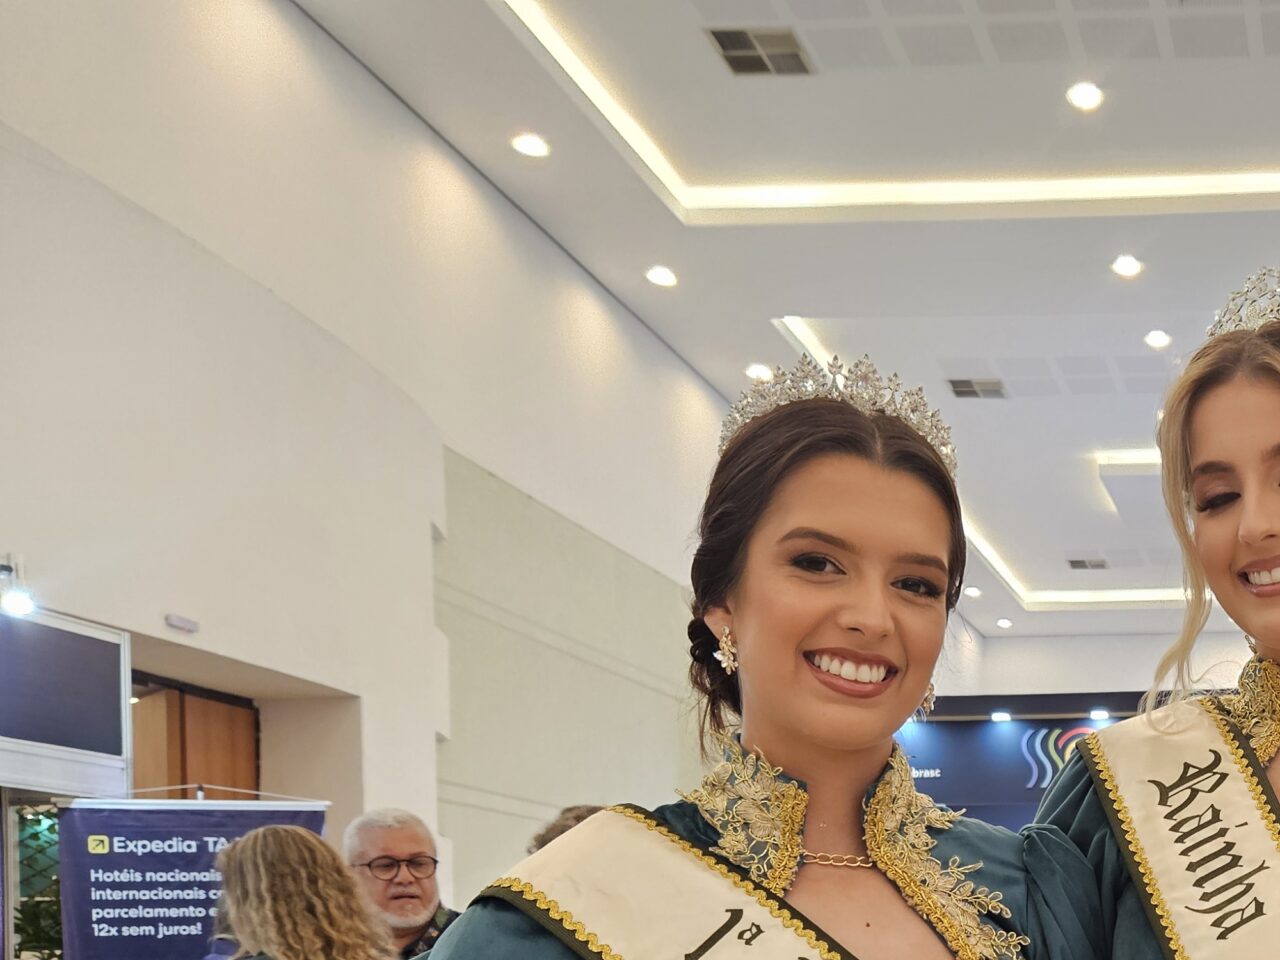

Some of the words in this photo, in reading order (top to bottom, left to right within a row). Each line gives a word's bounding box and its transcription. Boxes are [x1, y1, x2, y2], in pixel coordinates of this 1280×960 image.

[113, 836, 197, 856] Expedia
[203, 836, 232, 853] TA
[1147, 749, 1270, 940] Rainha
[90, 869, 143, 882] Hotéis
[146, 869, 223, 882] nacionais
[91, 887, 206, 901] internacionais
[92, 905, 206, 922] parcelamento
[92, 923, 119, 937] 12x
[121, 926, 155, 936] sem
[157, 922, 202, 939] juros!
